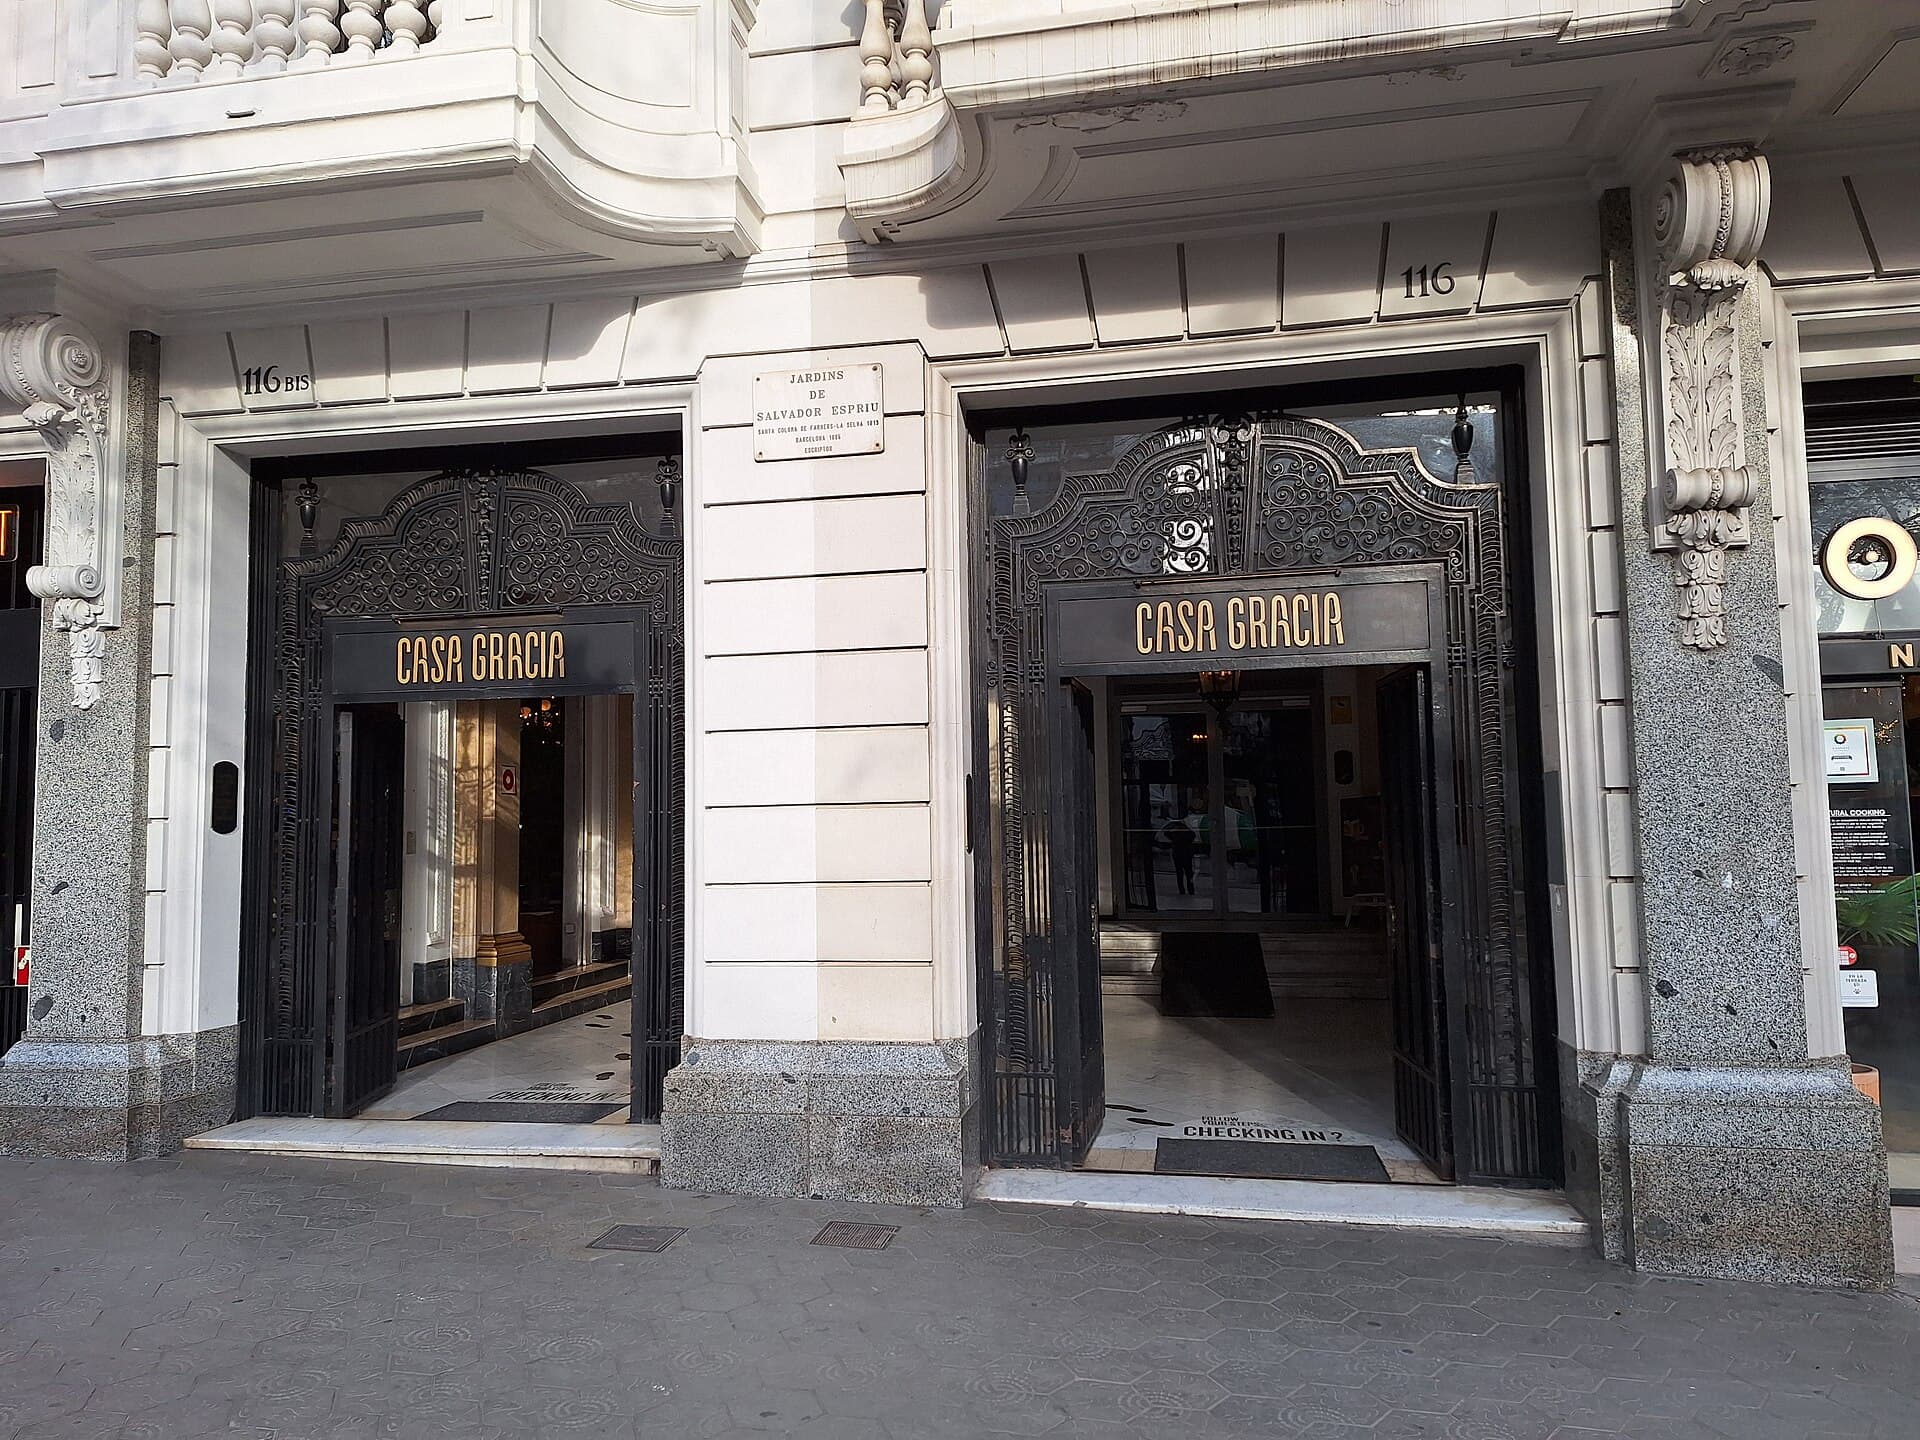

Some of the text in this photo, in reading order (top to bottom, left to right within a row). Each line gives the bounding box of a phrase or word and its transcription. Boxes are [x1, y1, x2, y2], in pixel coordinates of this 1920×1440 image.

[1400, 262, 1456, 299] 116
[242, 365, 309, 395] 116 BIS
[790, 370, 844, 384] JARDINS
[809, 389, 826, 400] DE
[757, 402, 879, 421] SALVADOR ESPRIU
[1135, 592, 1345, 654] CASA GRACIA
[396, 630, 565, 685] CASA GRACIA
[1183, 1126, 1296, 1140] CHECKING
